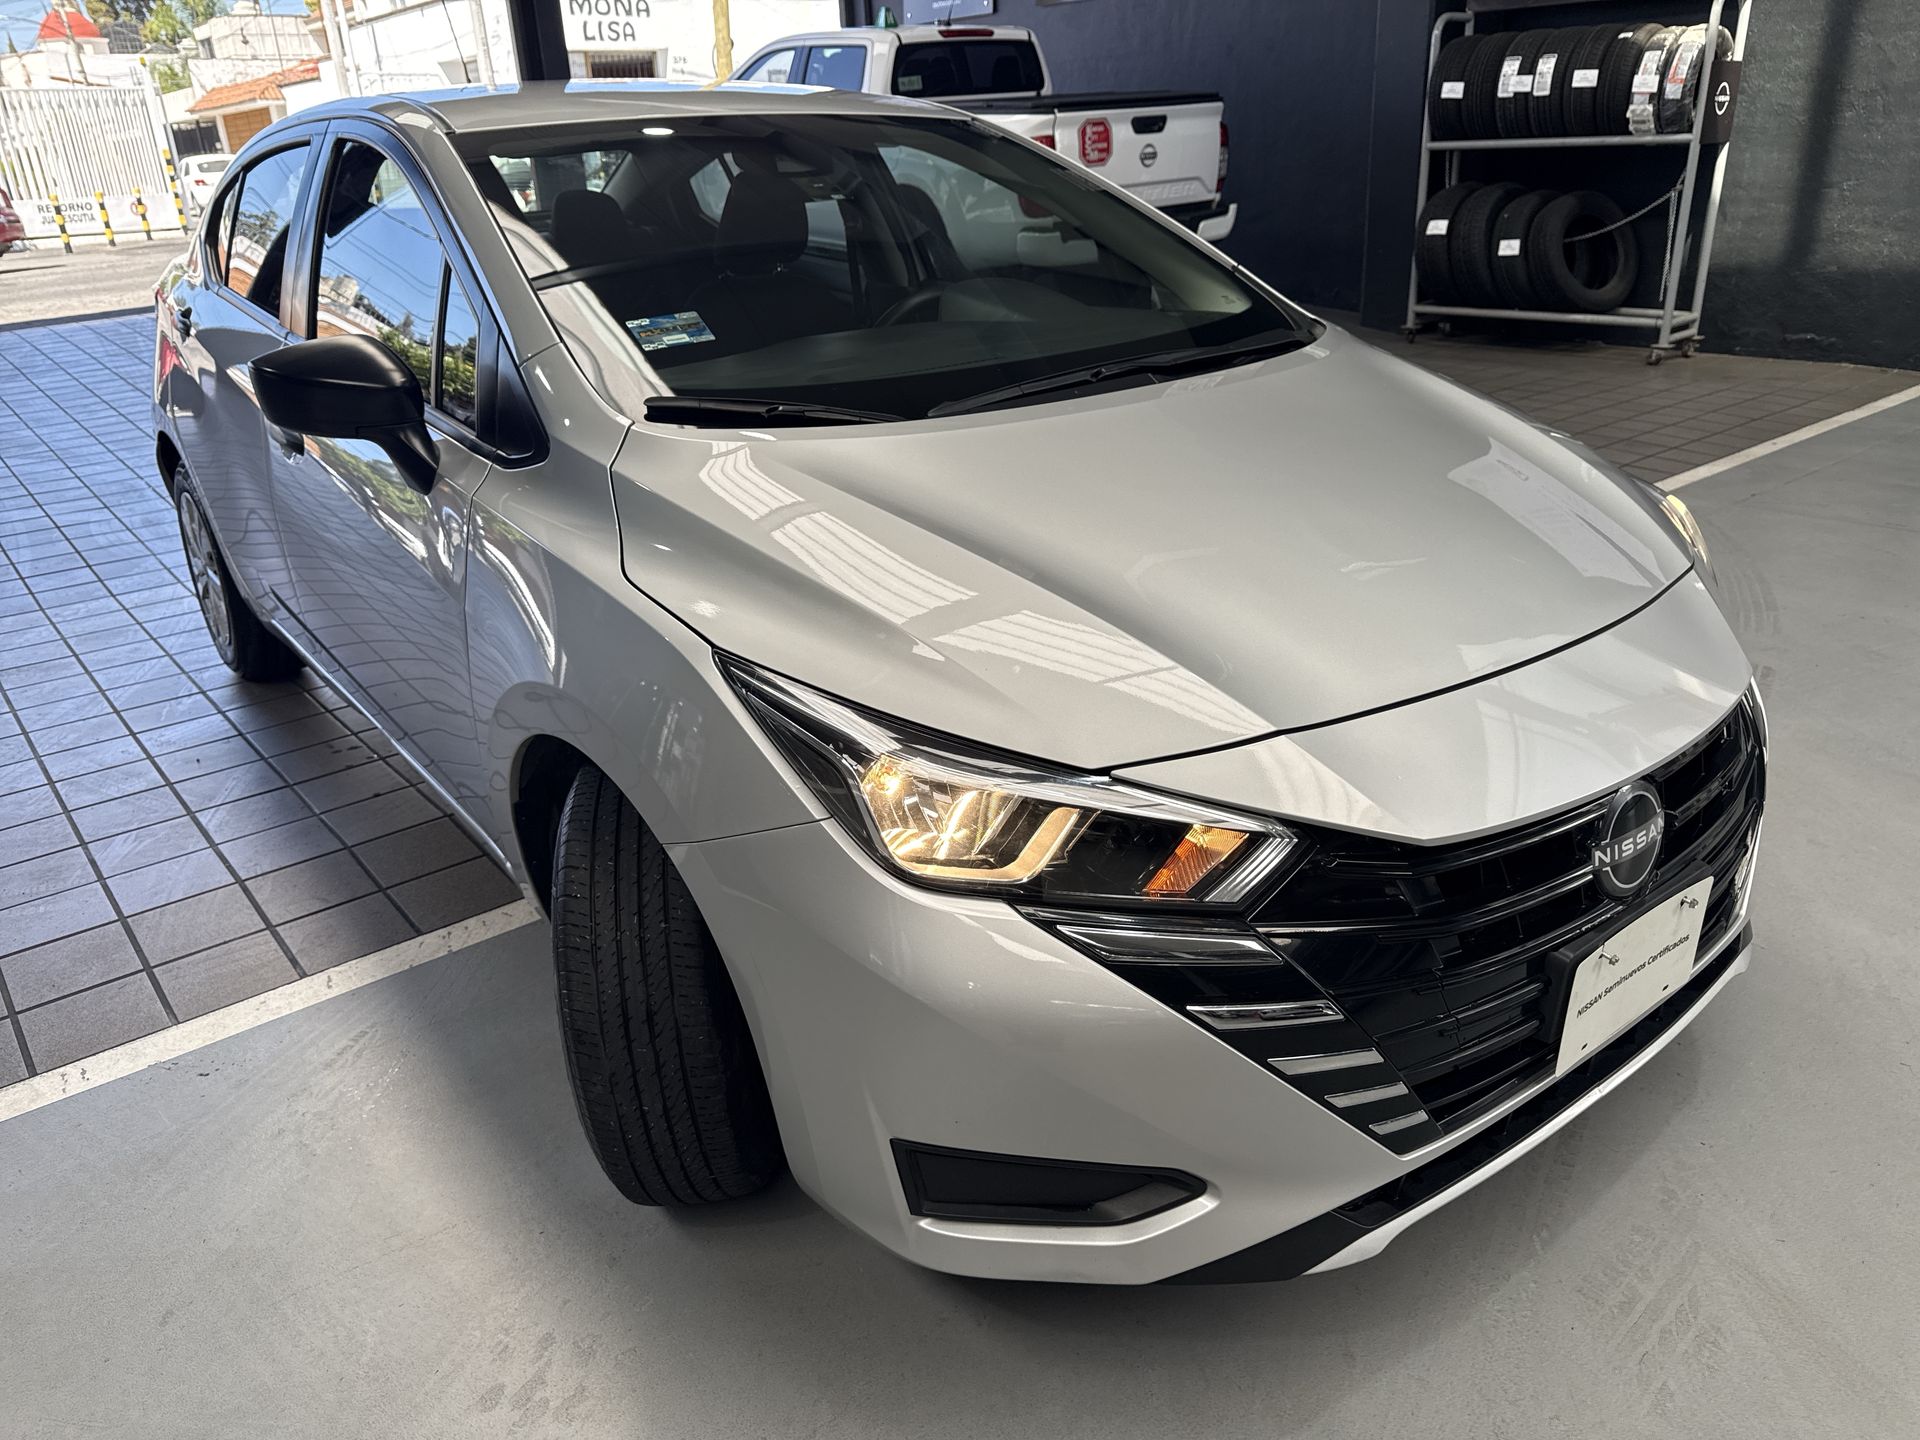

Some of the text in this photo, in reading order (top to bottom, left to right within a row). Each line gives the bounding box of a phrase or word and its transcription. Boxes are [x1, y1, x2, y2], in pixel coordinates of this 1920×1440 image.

[569, 0, 650, 17] MONA
[583, 20, 636, 41] LISA
[37, 202, 92, 213] REORNO
[1594, 816, 1665, 867] NISSAN
[1577, 934, 1690, 1018] NISSAN Seminuevos Certificados
